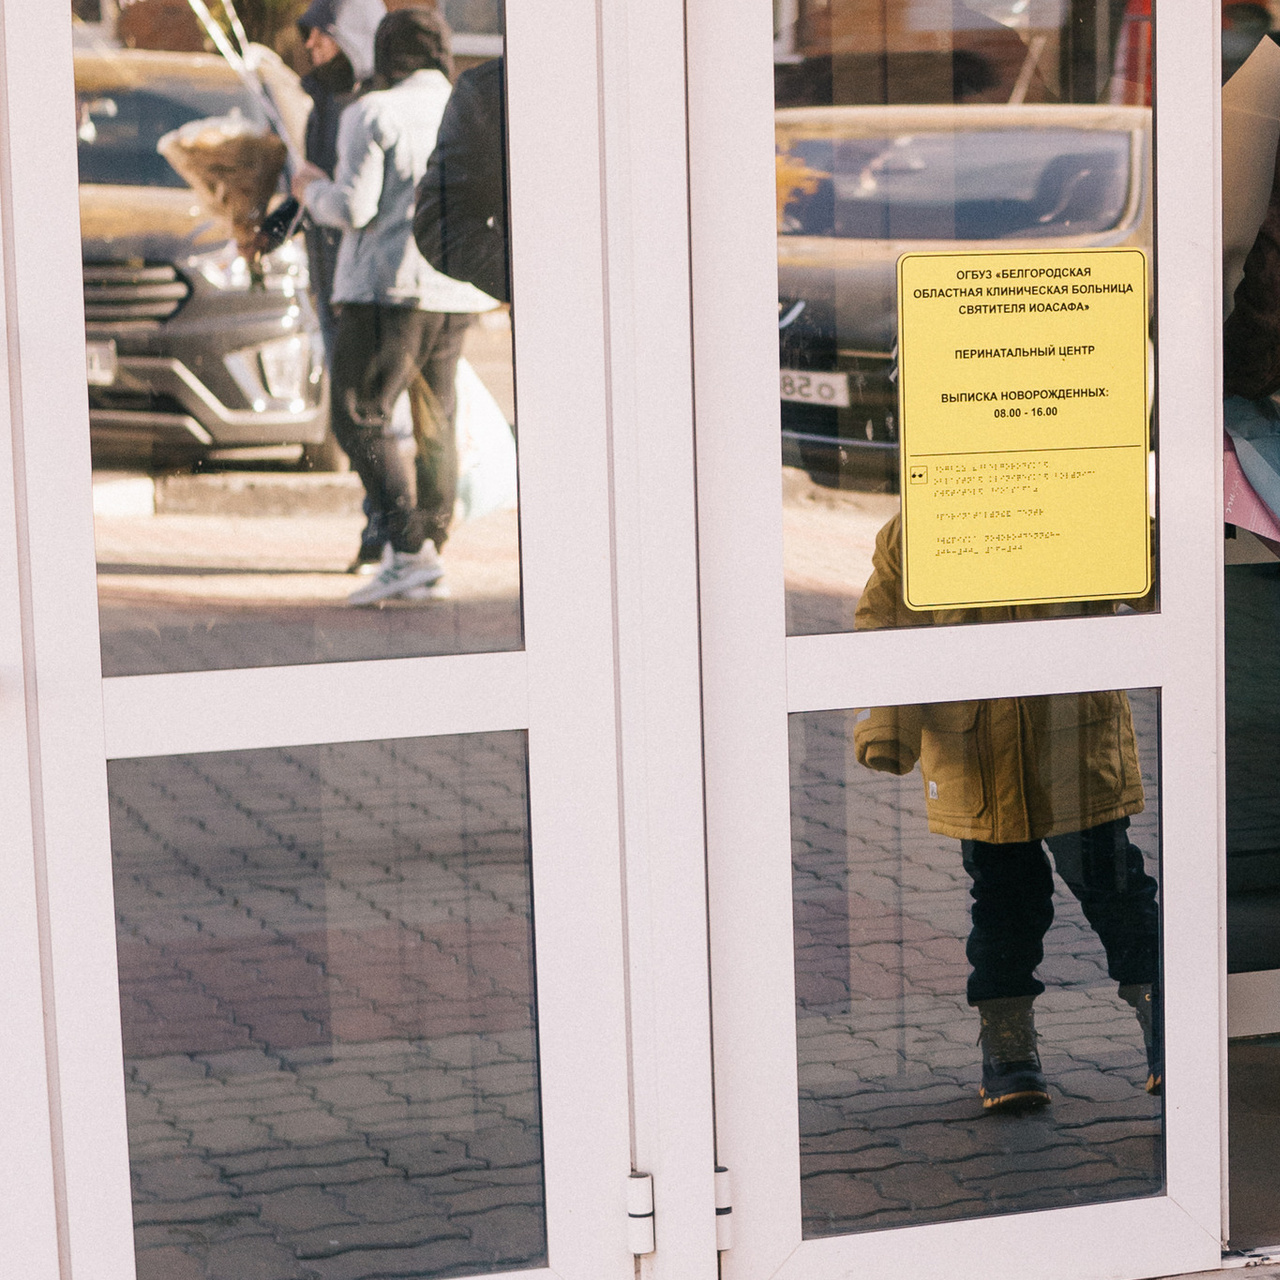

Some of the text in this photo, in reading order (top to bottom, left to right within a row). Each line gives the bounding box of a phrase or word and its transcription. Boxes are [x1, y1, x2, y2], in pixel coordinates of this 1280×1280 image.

[956, 267, 1092, 281] ОГБУЗ «БЕЛГОРОДСКАЯ
[913, 283, 1134, 299] ОБЛАСТНАЯ КЛИНИЧЕСКАЯ БОЛЬНИЦА
[958, 301, 1090, 315] СВЯТИТЕЛЯ ИОАСАФА»
[954, 344, 1096, 360] ПЕРИНАТАЛЬНЫЙ ЦЕНТР
[941, 387, 1110, 403] ВЫПИСКА НОВОРОЖДЕННЫХ:
[993, 407, 1022, 419] 08.00
[1031, 406, 1058, 417] 16.00
